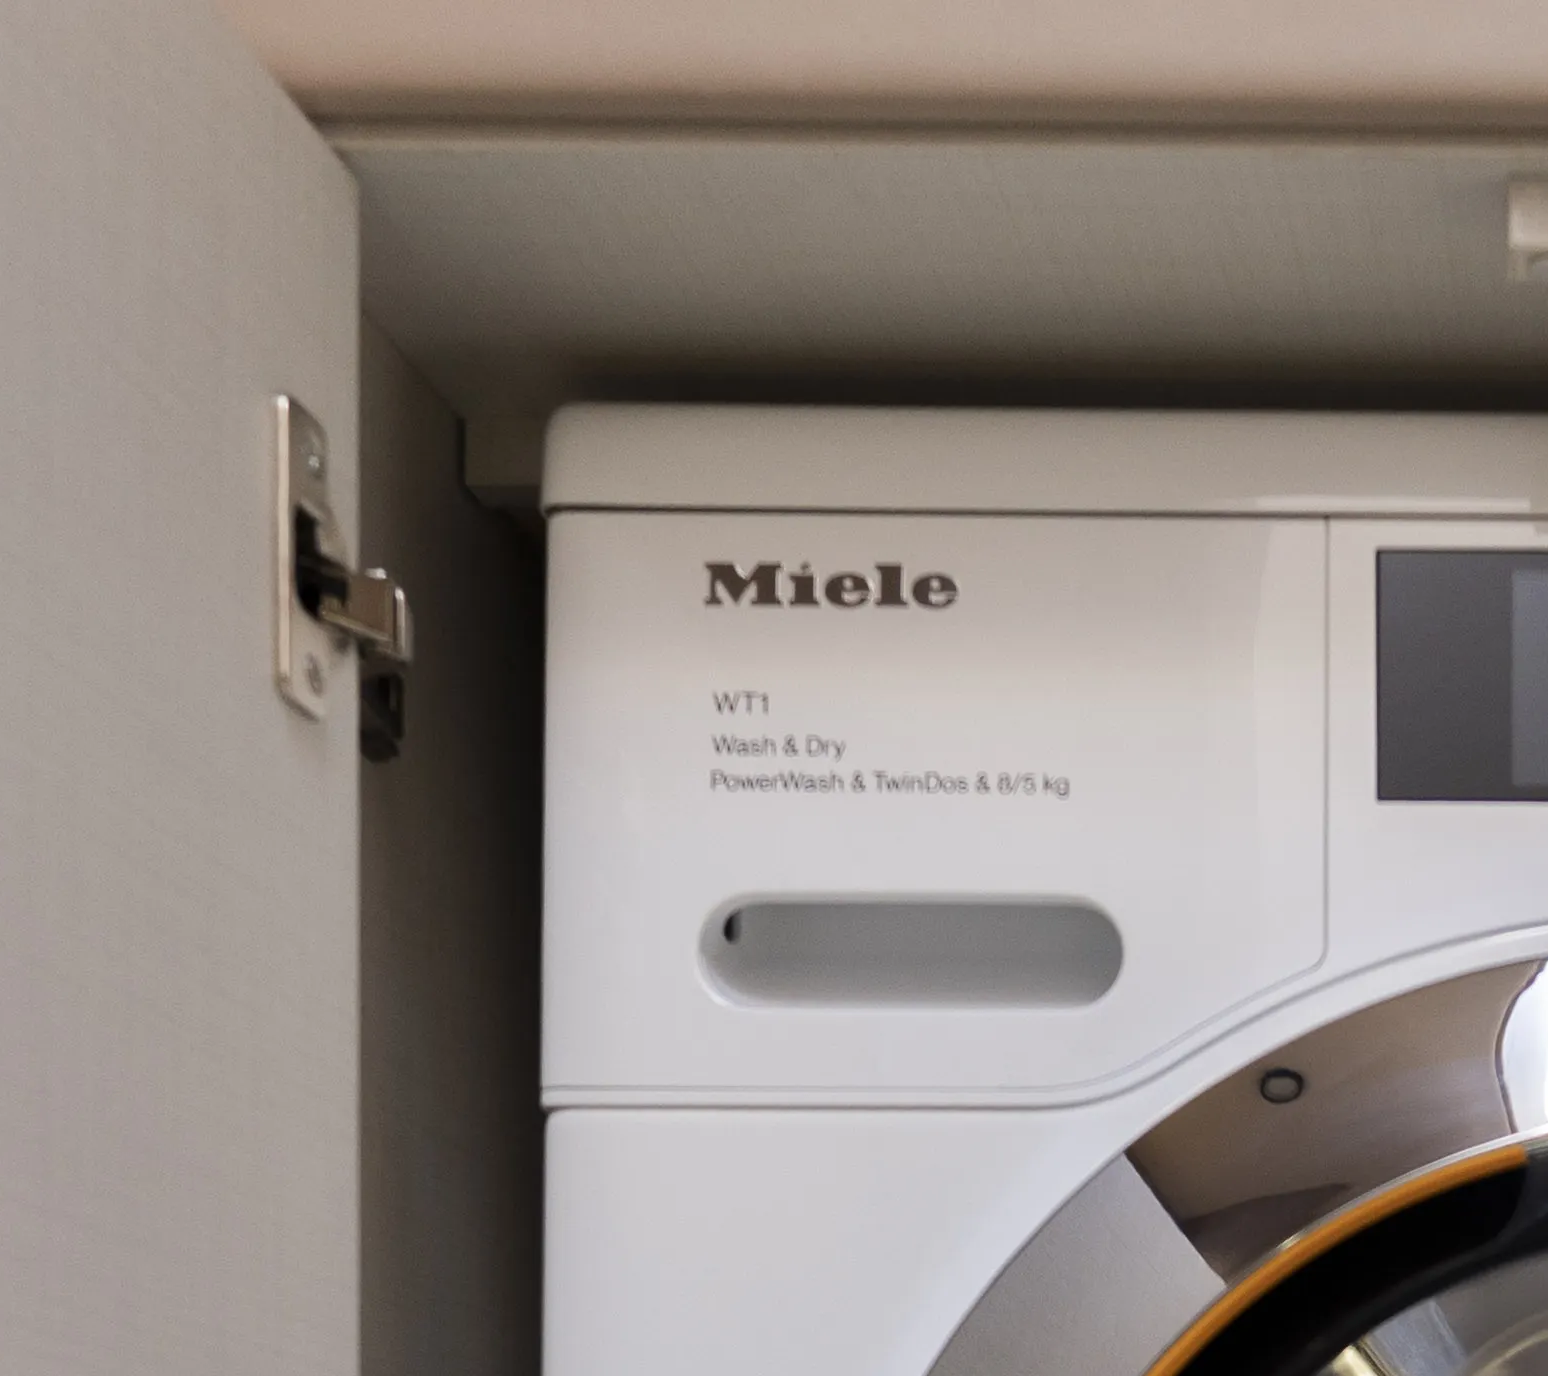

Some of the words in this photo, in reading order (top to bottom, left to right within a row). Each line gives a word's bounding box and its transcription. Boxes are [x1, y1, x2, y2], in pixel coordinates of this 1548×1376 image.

[704, 561, 958, 608] Miele
[712, 690, 769, 715] WT1
[711, 734, 777, 757] Wash
[782, 733, 799, 757] &
[805, 734, 846, 763] Dry
[709, 768, 845, 793] PowerWash
[851, 769, 866, 793] &
[872, 770, 969, 794] TwinDos
[975, 771, 990, 795] &
[1042, 773, 1070, 800] kg
